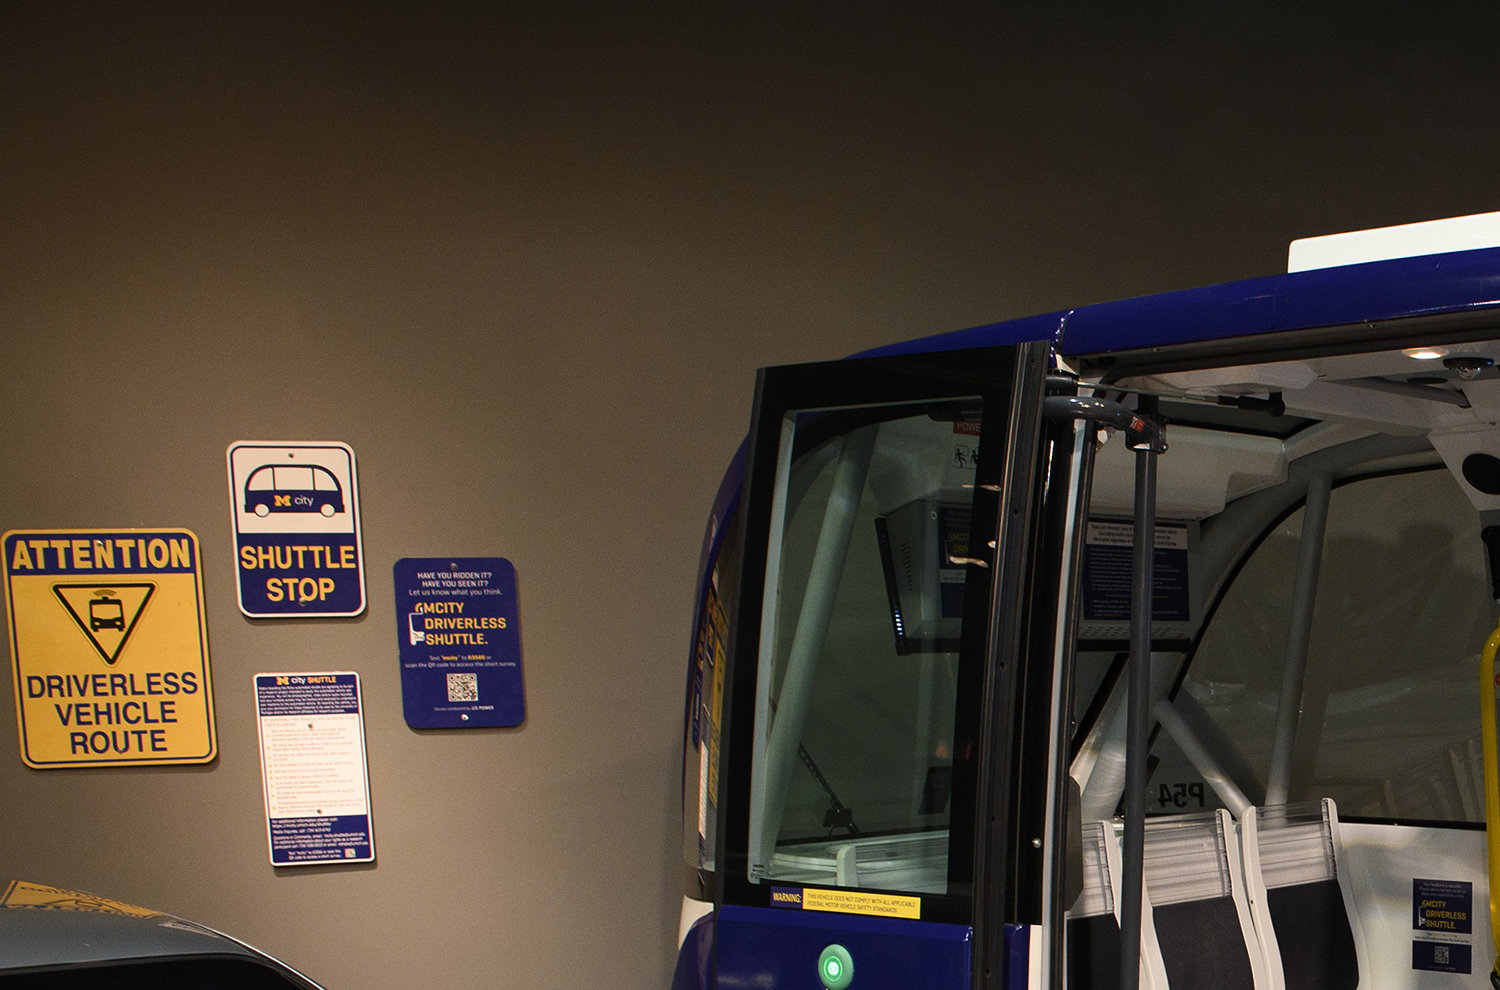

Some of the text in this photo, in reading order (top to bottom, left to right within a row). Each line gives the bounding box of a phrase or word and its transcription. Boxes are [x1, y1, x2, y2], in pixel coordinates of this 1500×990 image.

[273, 494, 314, 507] M city
[11, 538, 191, 570] ATTENTION
[240, 545, 356, 570] SHUTTLE
[481, 571, 492, 579] IT?
[266, 577, 335, 602] STOP
[422, 580, 440, 588] HAVE
[441, 580, 456, 588] YOU
[451, 588, 469, 596] what
[424, 617, 507, 630] DRIVERLESS
[425, 633, 489, 645] SHUTTLE.
[26, 671, 198, 698] DRIVERLESS
[276, 676, 337, 685] M city SHUTTLE
[54, 701, 178, 726] VEHICLE
[70, 730, 168, 754] ROUTE
[772, 891, 802, 903] WARNING:
[854, 896, 871, 904] COMPLY
[891, 898, 916, 908] APPLICABLE
[839, 902, 856, 910] VEHICLE
[856, 903, 872, 911] SAFETY
[1425, 910, 1467, 920] DRIVERLESS
[1425, 920, 1457, 929] SHUTTLE.
